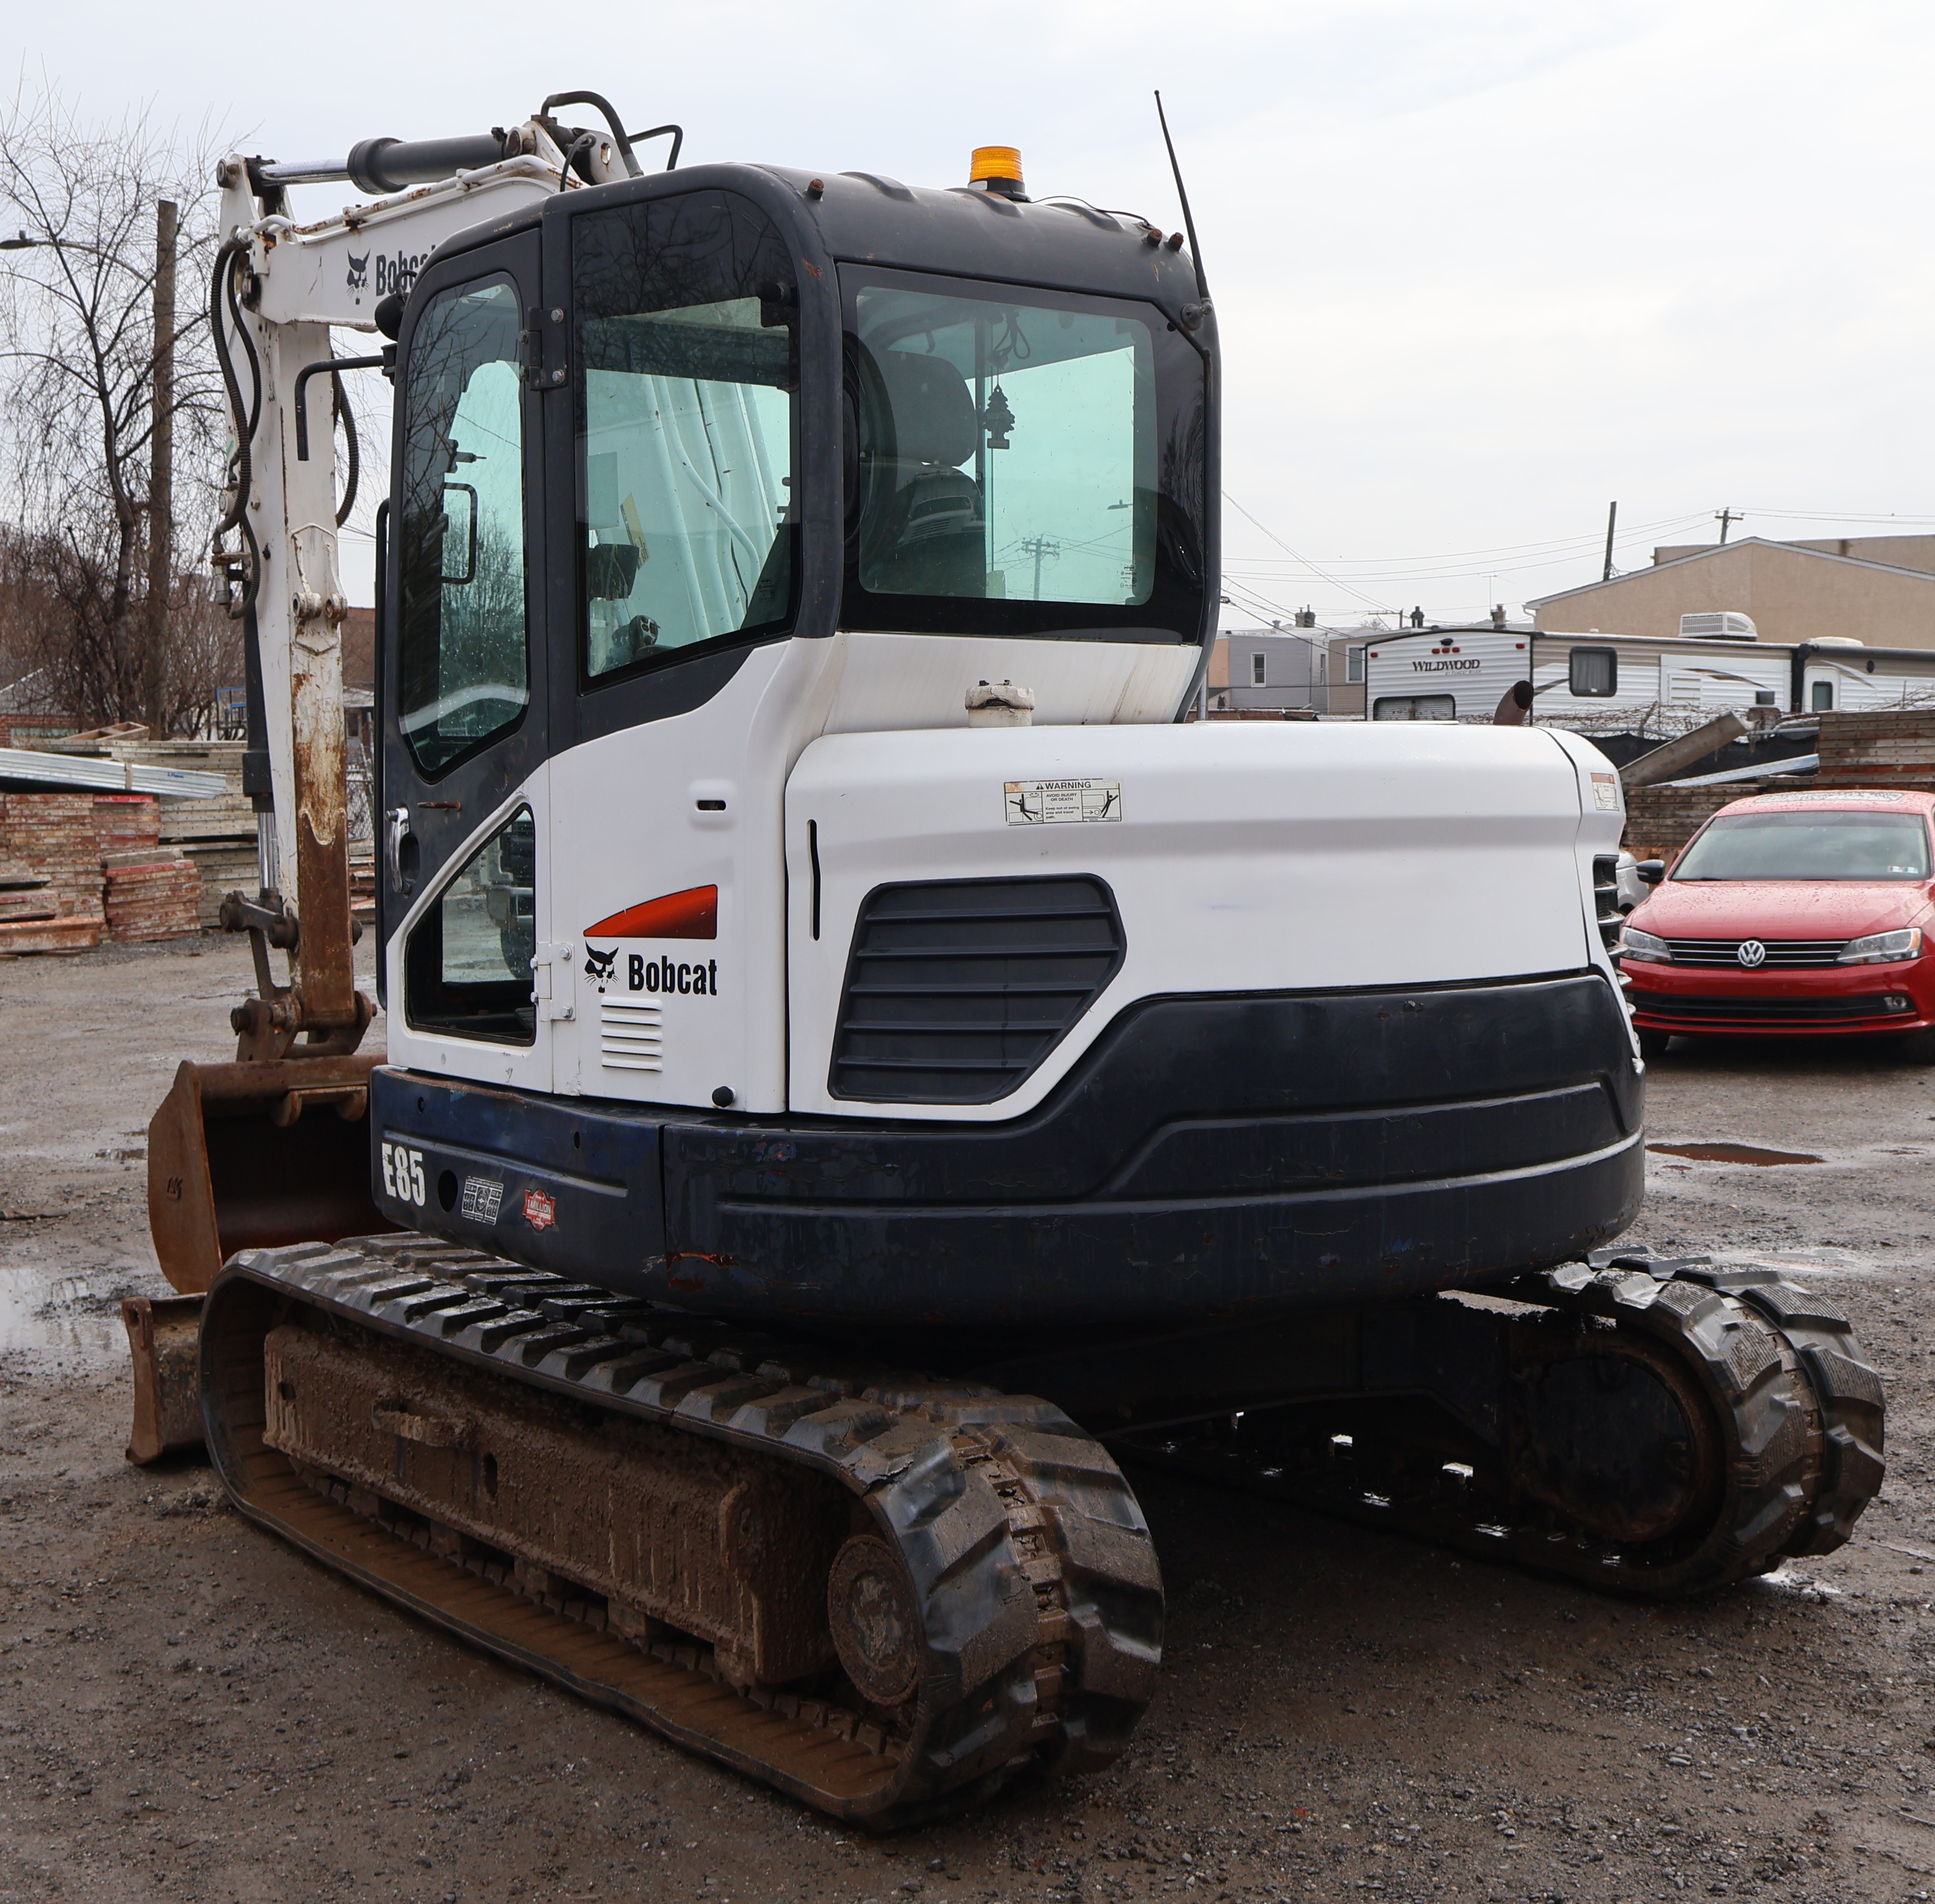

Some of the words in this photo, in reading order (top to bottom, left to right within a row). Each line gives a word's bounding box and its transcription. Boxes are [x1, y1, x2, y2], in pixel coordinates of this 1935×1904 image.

[376, 244, 436, 297] Bobc
[1412, 659, 1480, 672] WILDWOOD
[1045, 781, 1091, 790] WARNING
[628, 954, 717, 996] Bobcat
[382, 1142, 425, 1206] E85
[530, 1200, 551, 1214] MILLION
